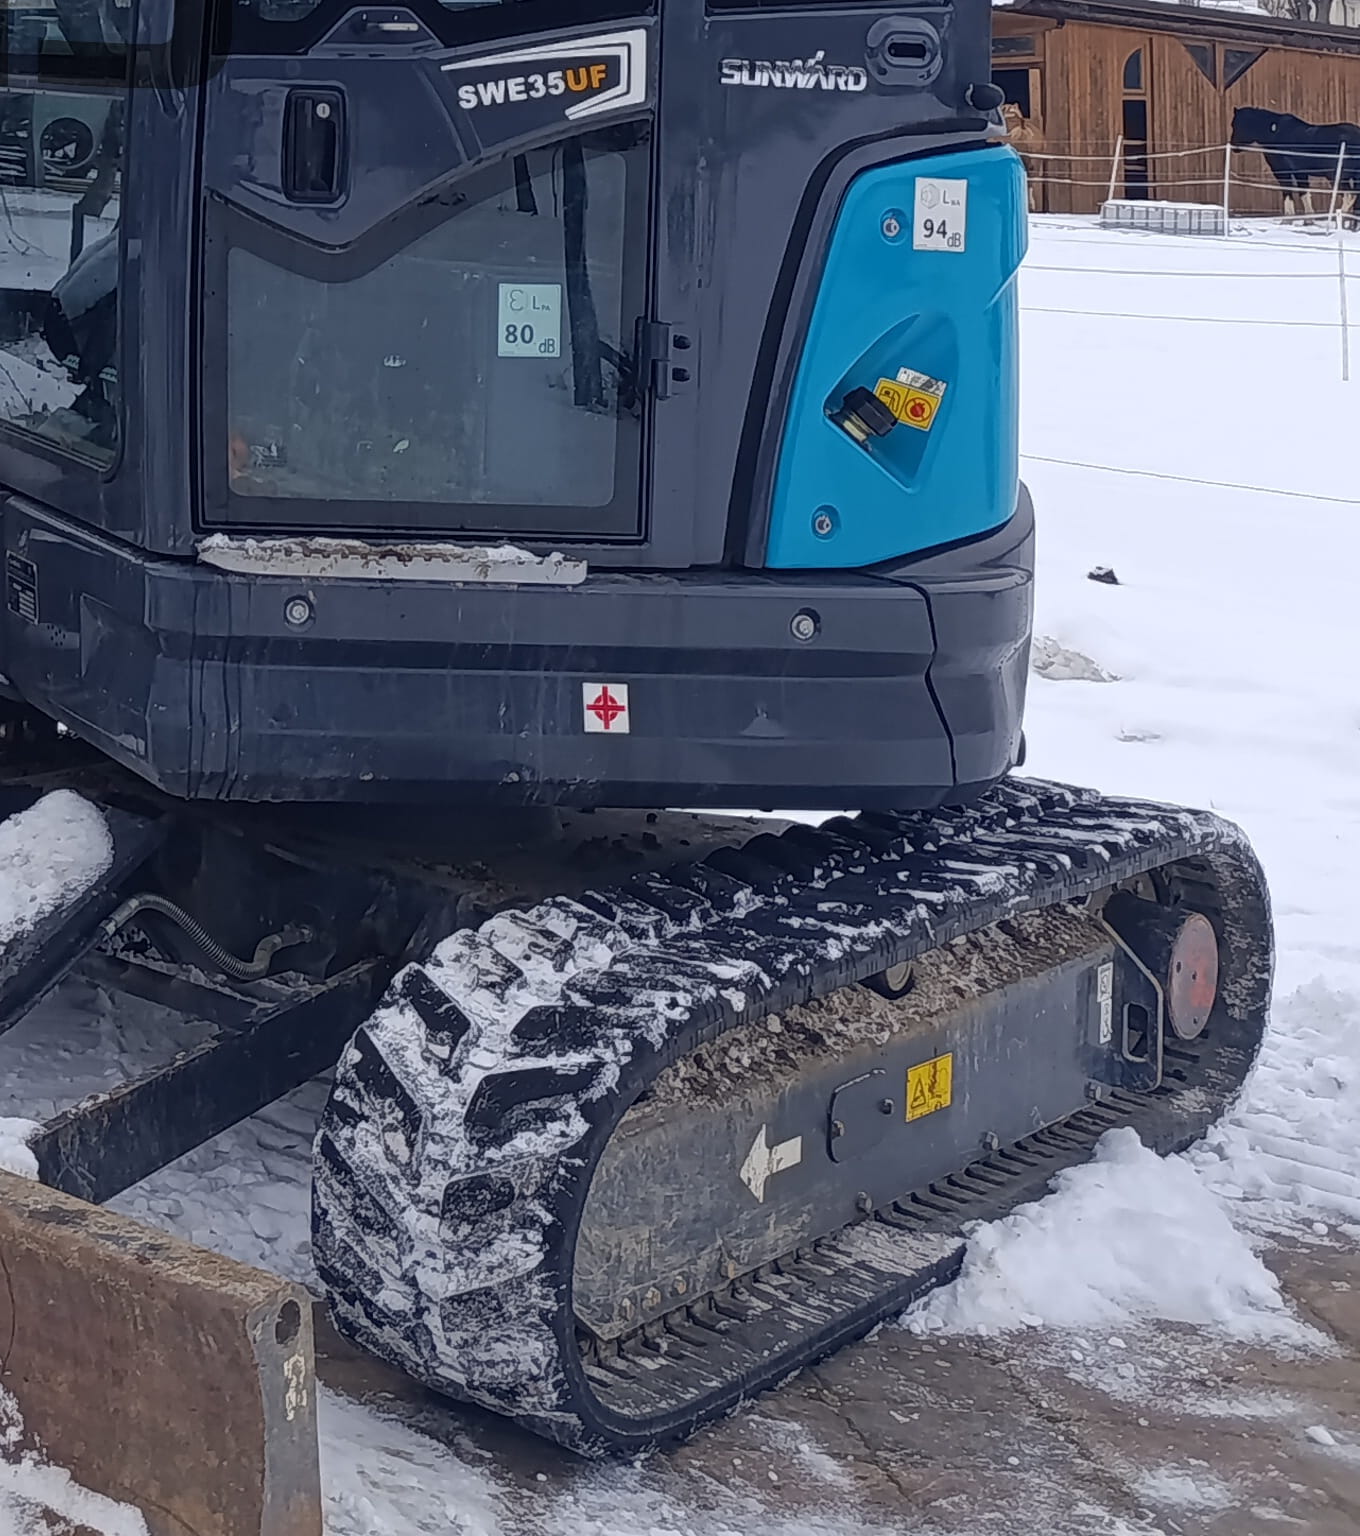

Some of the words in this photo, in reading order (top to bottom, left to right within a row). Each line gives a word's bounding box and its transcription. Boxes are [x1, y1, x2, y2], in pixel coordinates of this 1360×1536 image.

[457, 64, 607, 109] SWE35UF
[720, 50, 868, 92] SUNWARD
[923, 218, 948, 239] 94
[946, 231, 962, 248] dB
[505, 324, 534, 344] 80
[538, 338, 556, 354] dB
